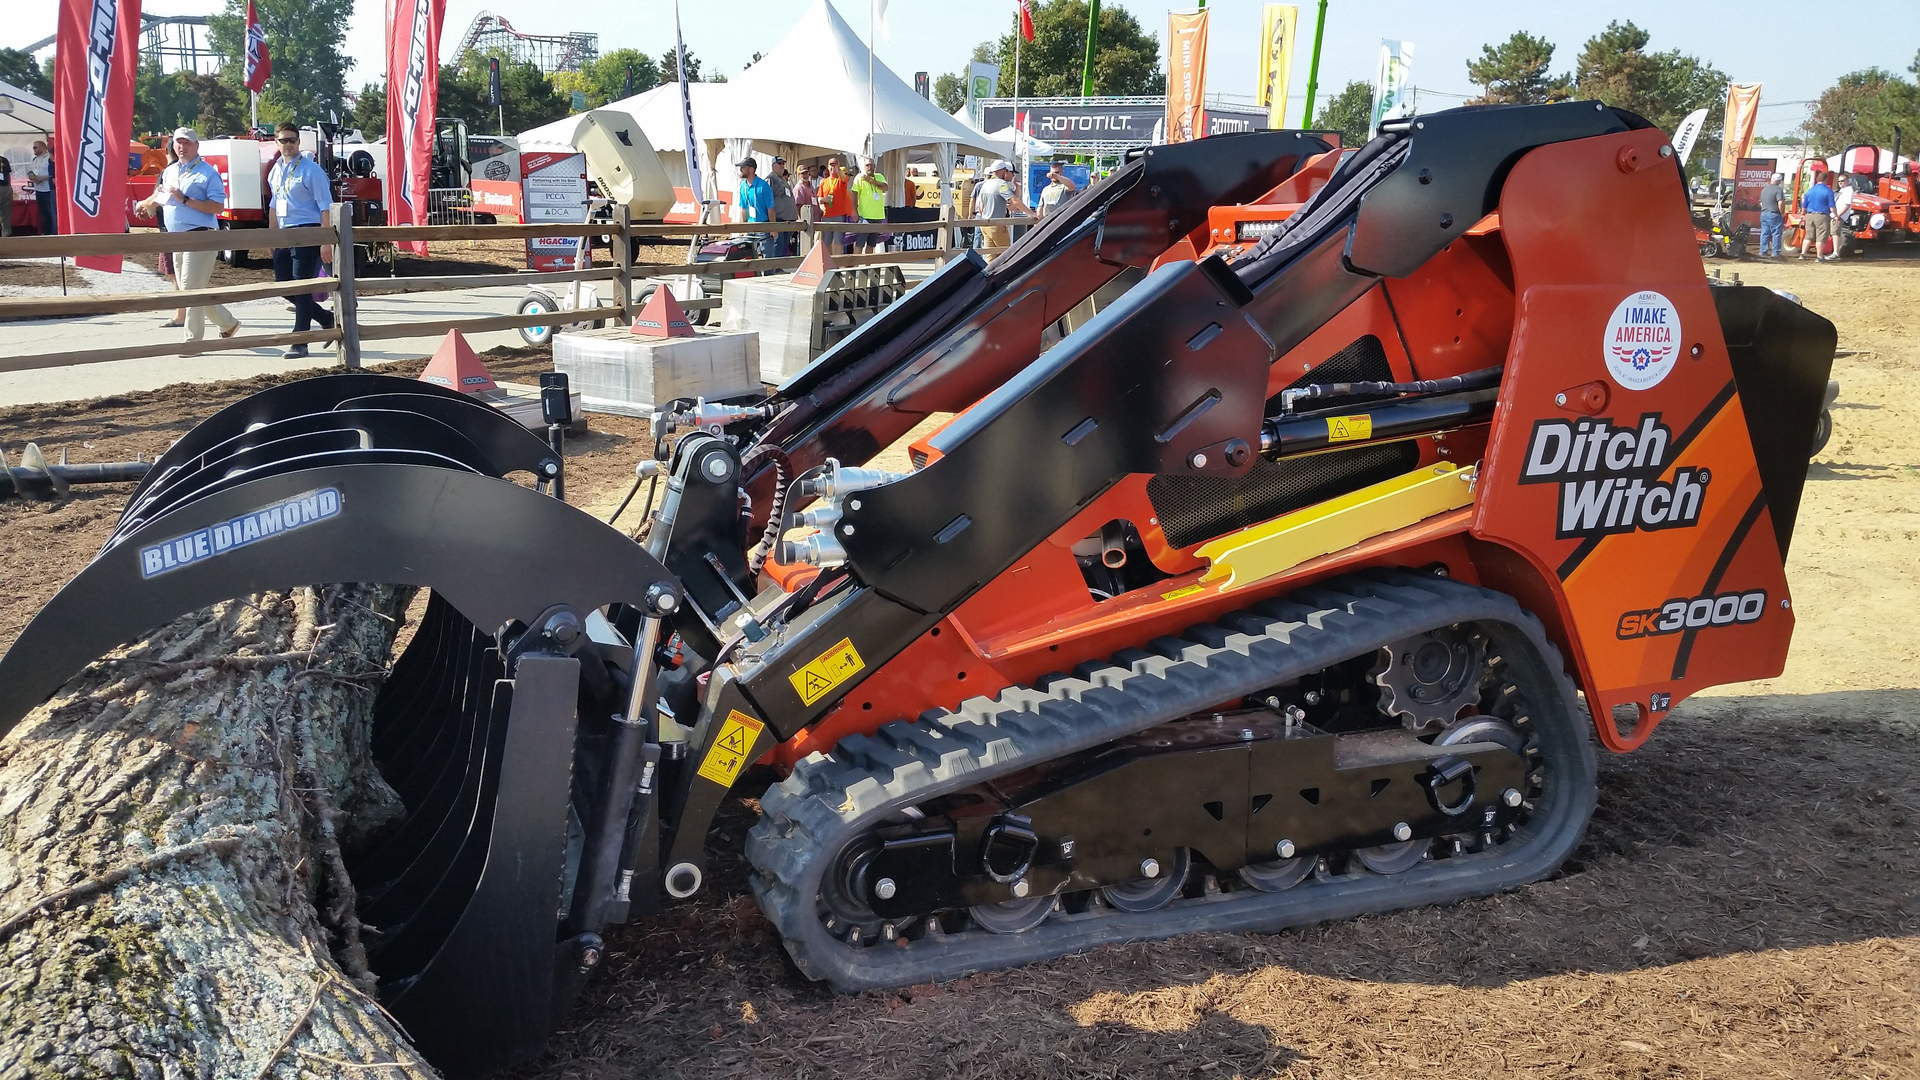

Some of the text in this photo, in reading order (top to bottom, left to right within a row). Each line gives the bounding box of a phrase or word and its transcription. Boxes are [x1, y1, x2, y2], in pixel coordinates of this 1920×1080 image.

[1182, 40, 1193, 141] MINI SKID STEER
[1041, 116, 1130, 131] ROTOTILT
[1747, 170, 1772, 178] POWER
[1615, 327, 1670, 343] AMERICA
[1625, 308, 1667, 324] I MAKE
[1526, 417, 1668, 477] Ditch
[1561, 471, 1702, 532] Witch
[143, 490, 338, 575] BLUE DIAMOND
[1620, 593, 1765, 637] SK3000
